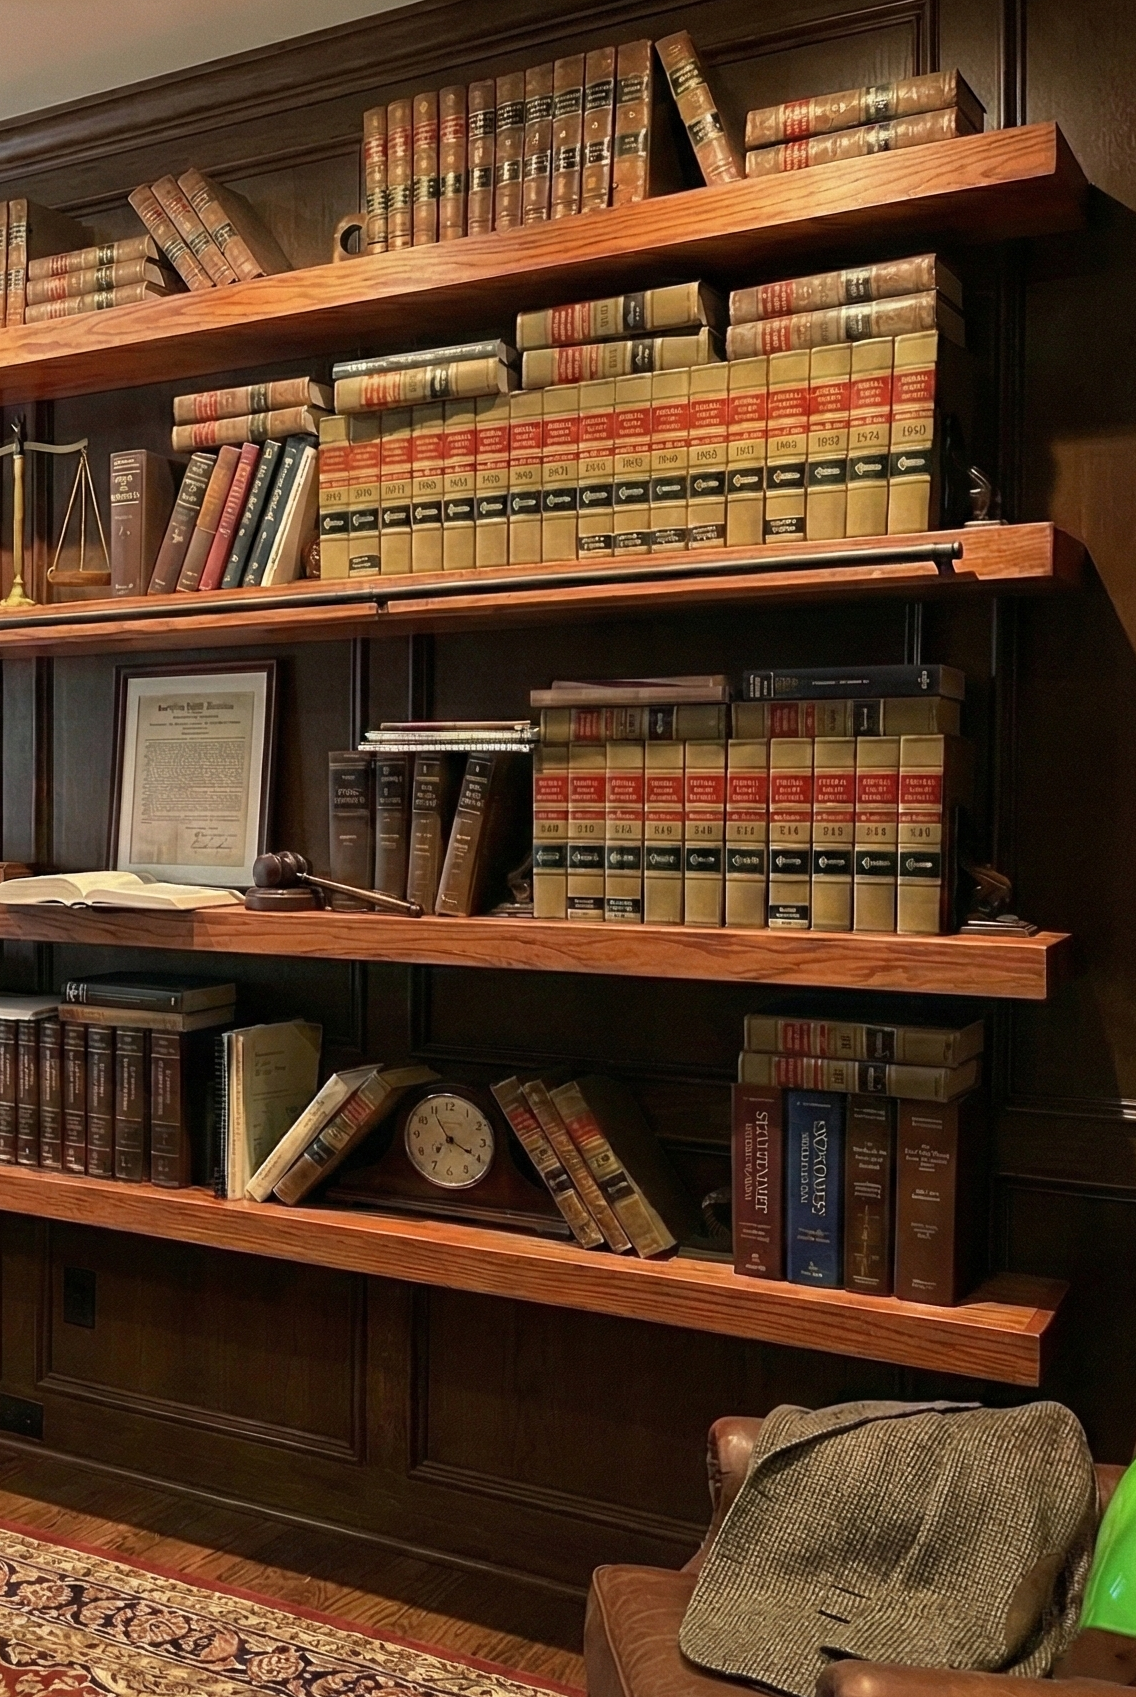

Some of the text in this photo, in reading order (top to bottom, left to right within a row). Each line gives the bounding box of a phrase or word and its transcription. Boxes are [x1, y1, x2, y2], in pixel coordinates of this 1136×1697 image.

[431, 1105, 438, 1115] 11
[445, 1102, 455, 1111] 12
[475, 1121, 482, 1131] 2
[413, 1130, 420, 1138] 9
[479, 1138, 486, 1148] 3
[431, 1160, 438, 1170] 7
[446, 1166, 453, 1176] 6
